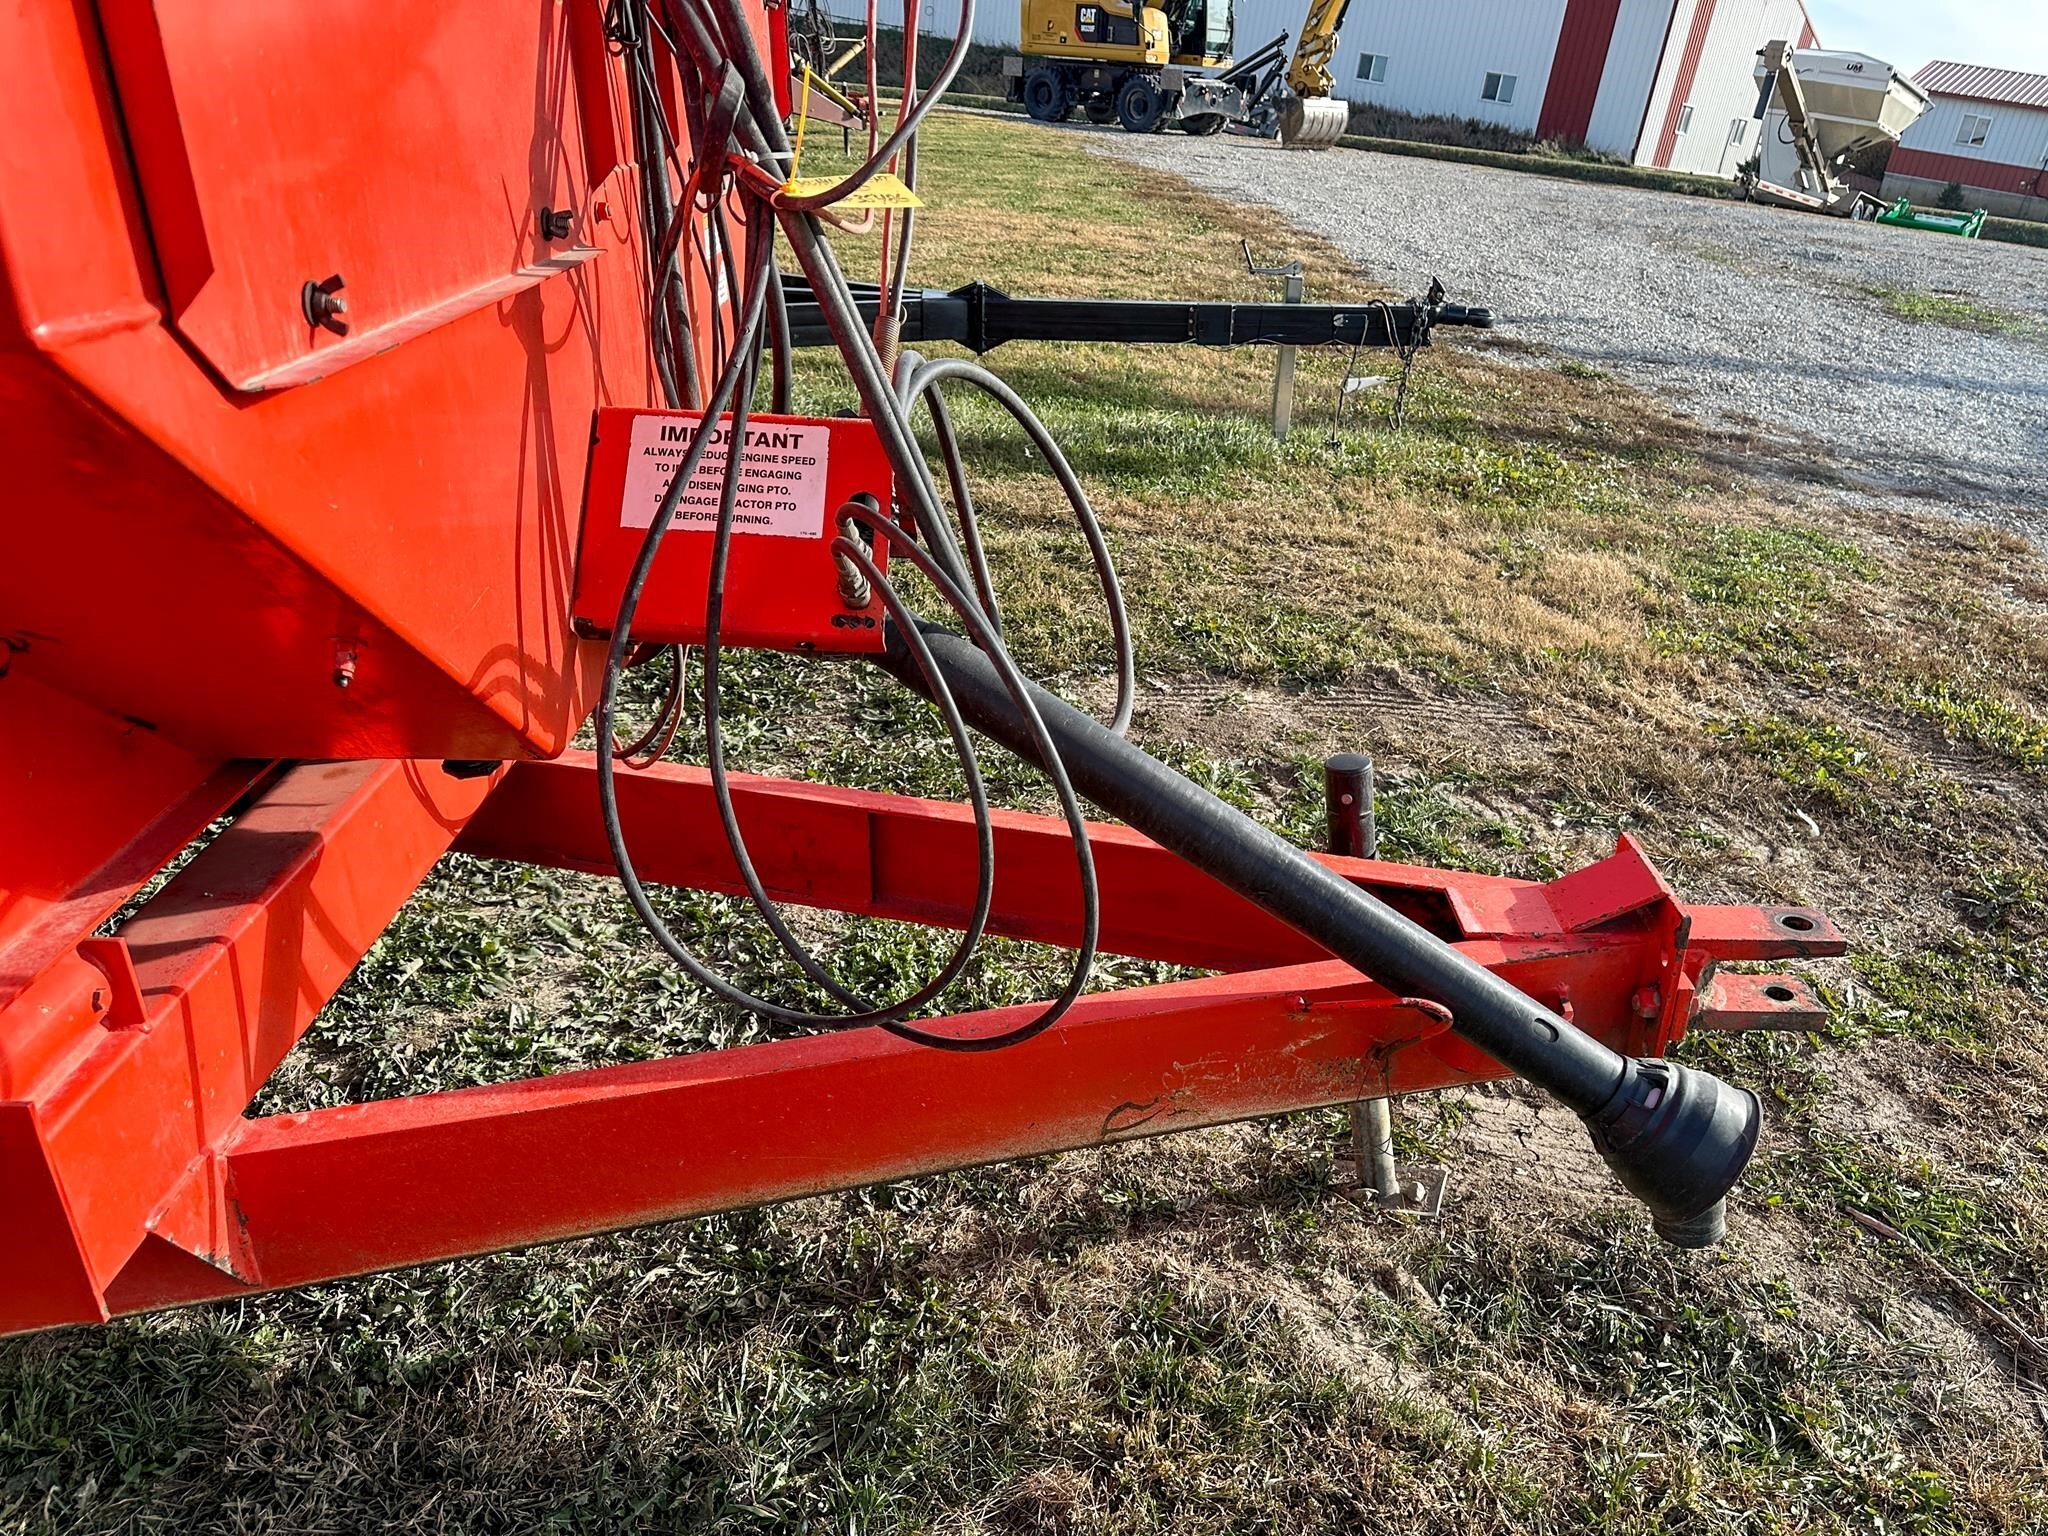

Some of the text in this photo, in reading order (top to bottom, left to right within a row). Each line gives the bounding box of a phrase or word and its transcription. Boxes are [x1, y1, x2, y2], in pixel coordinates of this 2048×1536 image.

[1080, 8, 1097, 23] CAT
[781, 455, 816, 466] SPEED
[655, 463, 670, 473] TO
[744, 468, 802, 481] ENGAGING
[688, 480, 764, 494] DISENGING
[766, 485, 792, 496] PTO.
[654, 494, 797, 512] DNGAGE ACTOR PTO
[674, 511, 774, 526] BEFORE URNING.
